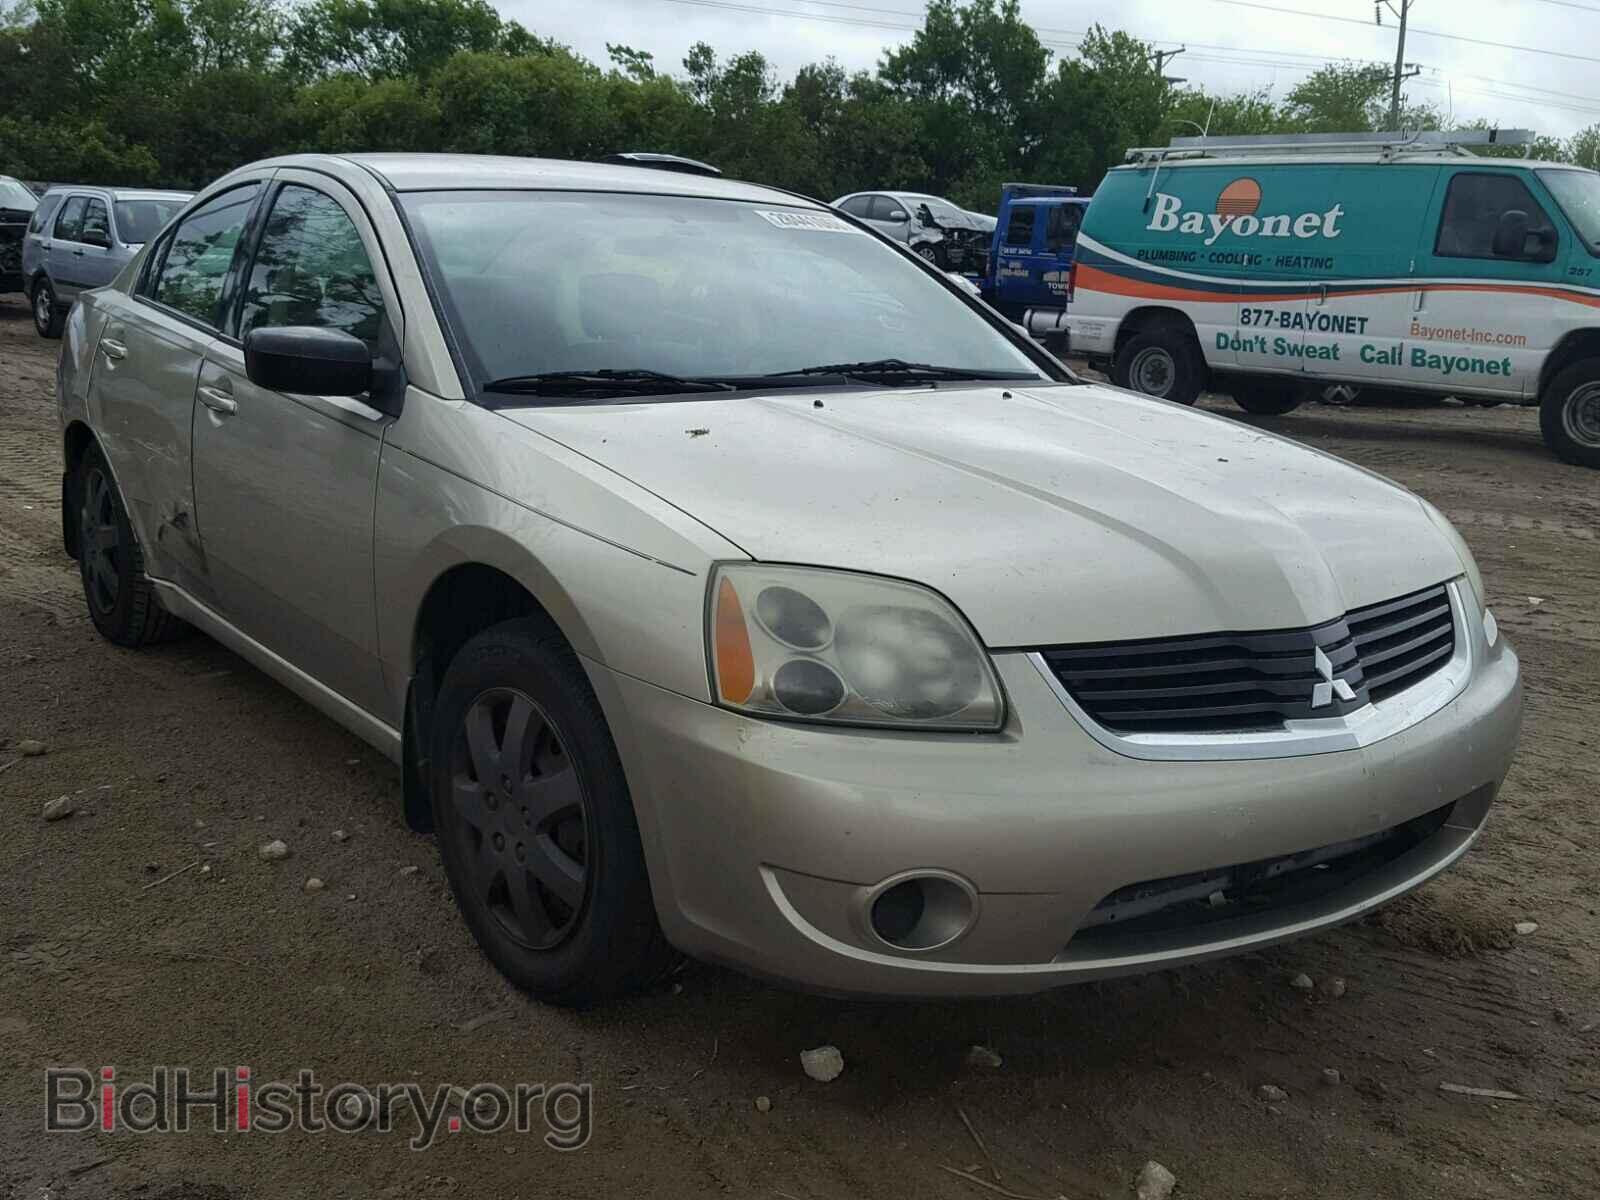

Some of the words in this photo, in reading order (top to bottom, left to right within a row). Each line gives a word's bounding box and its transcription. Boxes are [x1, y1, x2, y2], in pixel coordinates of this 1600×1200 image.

[1146, 192, 1345, 246] Bayonet
[1136, 249, 1196, 262] PLUMBING
[1275, 255, 1334, 270] HEATING
[1240, 308, 1369, 335] 877-BAYONET
[1410, 322, 1527, 346] Bayonet-Inc.com
[1216, 332, 1267, 353] Don't
[1273, 337, 1340, 361] Sweat
[1359, 344, 1404, 366] Call
[1411, 348, 1512, 376] Bayonet
